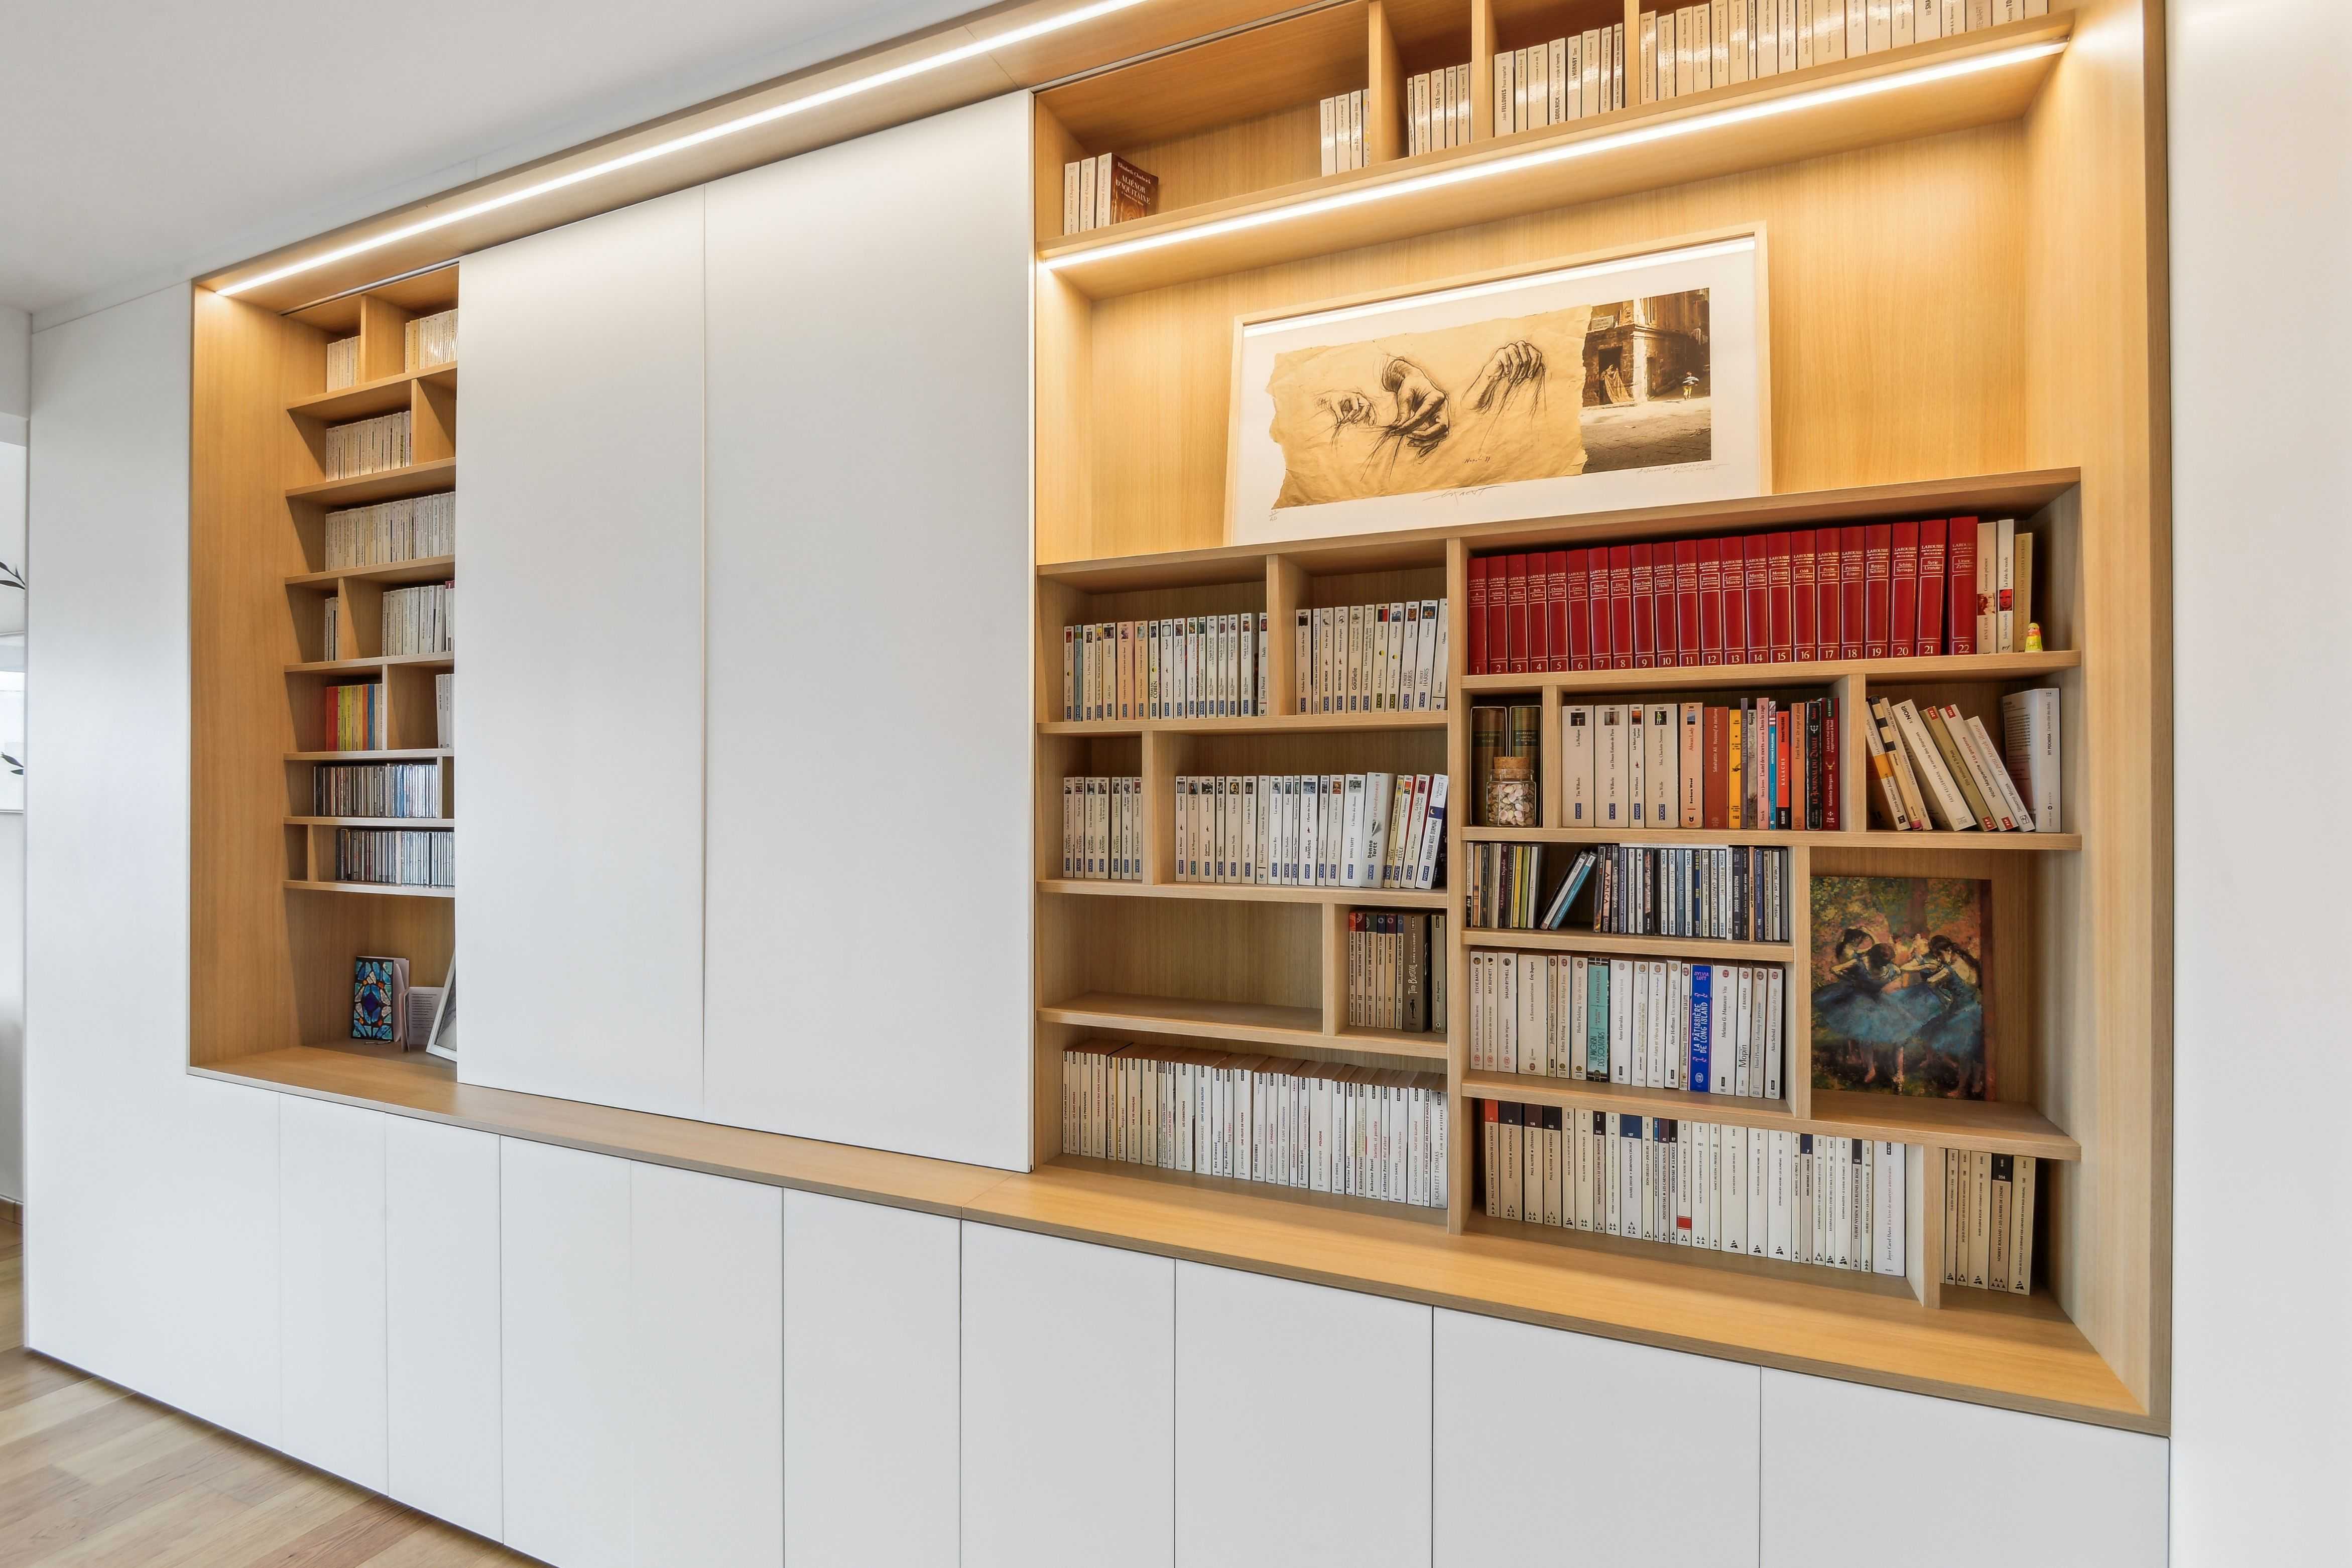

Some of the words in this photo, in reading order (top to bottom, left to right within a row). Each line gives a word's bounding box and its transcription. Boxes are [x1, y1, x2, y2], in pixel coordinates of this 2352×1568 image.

[1118, 162, 1134, 174] Elizabeth
[1121, 175, 1146, 194] ALIÉNOR
[1116, 179, 1151, 204] D'AQUITAINE
[1847, 649, 1857, 658] 18
[1872, 648, 1881, 657] 19
[1897, 647, 1908, 655] 20
[1958, 645, 1969, 653] 22
[1777, 652, 1786, 661] 15
[1801, 651, 1809, 659] 16
[1663, 657, 1671, 665] 10
[1686, 657, 1693, 665] 11
[1901, 705, 1912, 720] NOIR
[1962, 737, 1974, 755] garçonne
[1811, 759, 1817, 768] DU
[1976, 764, 1990, 787] Margueritte
[1810, 769, 1819, 796] JOURNAL
[1987, 786, 1996, 798] Victor
[1692, 1003, 1701, 1041] PÂTISSIÈRE
[1700, 1044, 1706, 1053] DE
[1739, 1044, 1748, 1068] Mopin
